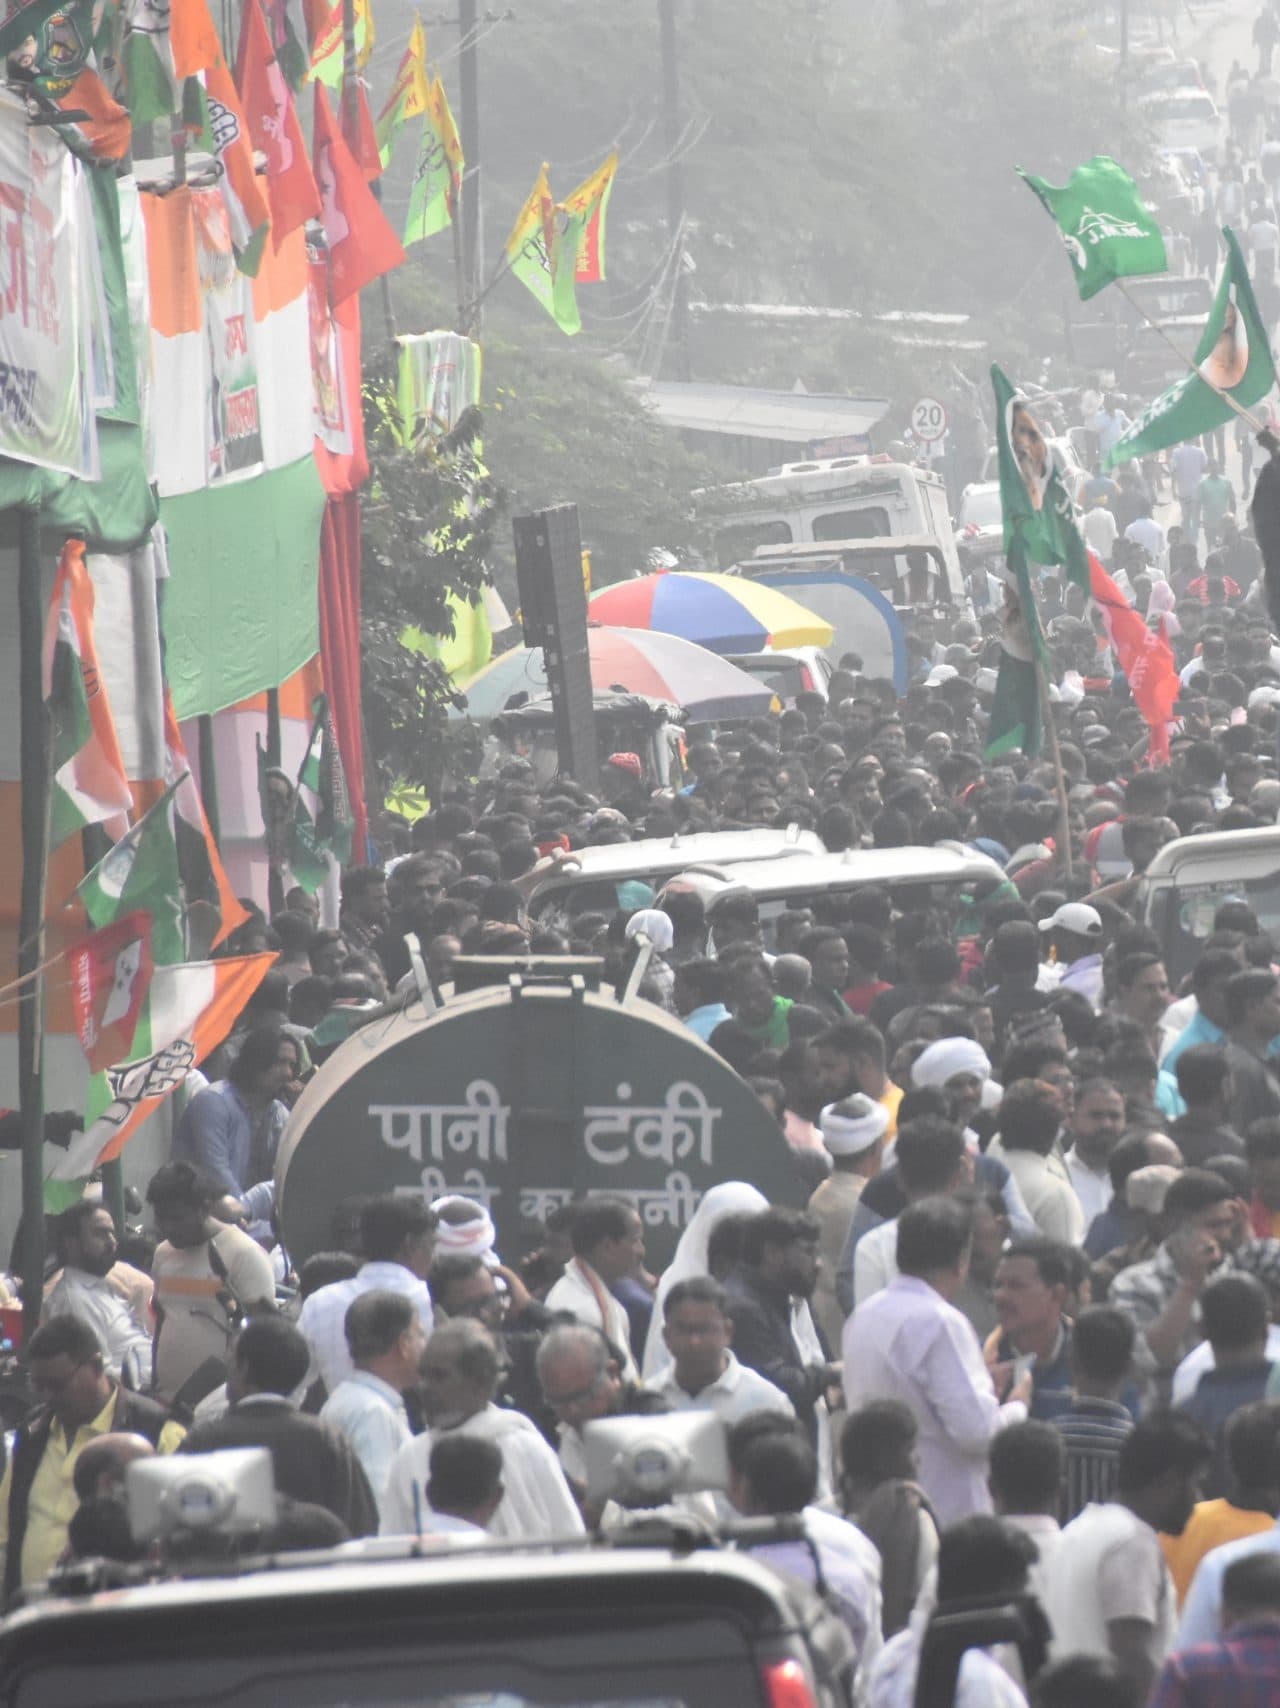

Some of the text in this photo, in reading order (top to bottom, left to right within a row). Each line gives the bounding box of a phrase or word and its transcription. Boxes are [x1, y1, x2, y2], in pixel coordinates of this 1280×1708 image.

[916, 406, 941, 426] 20
[369, 1079, 722, 1166] पानी टंकी
